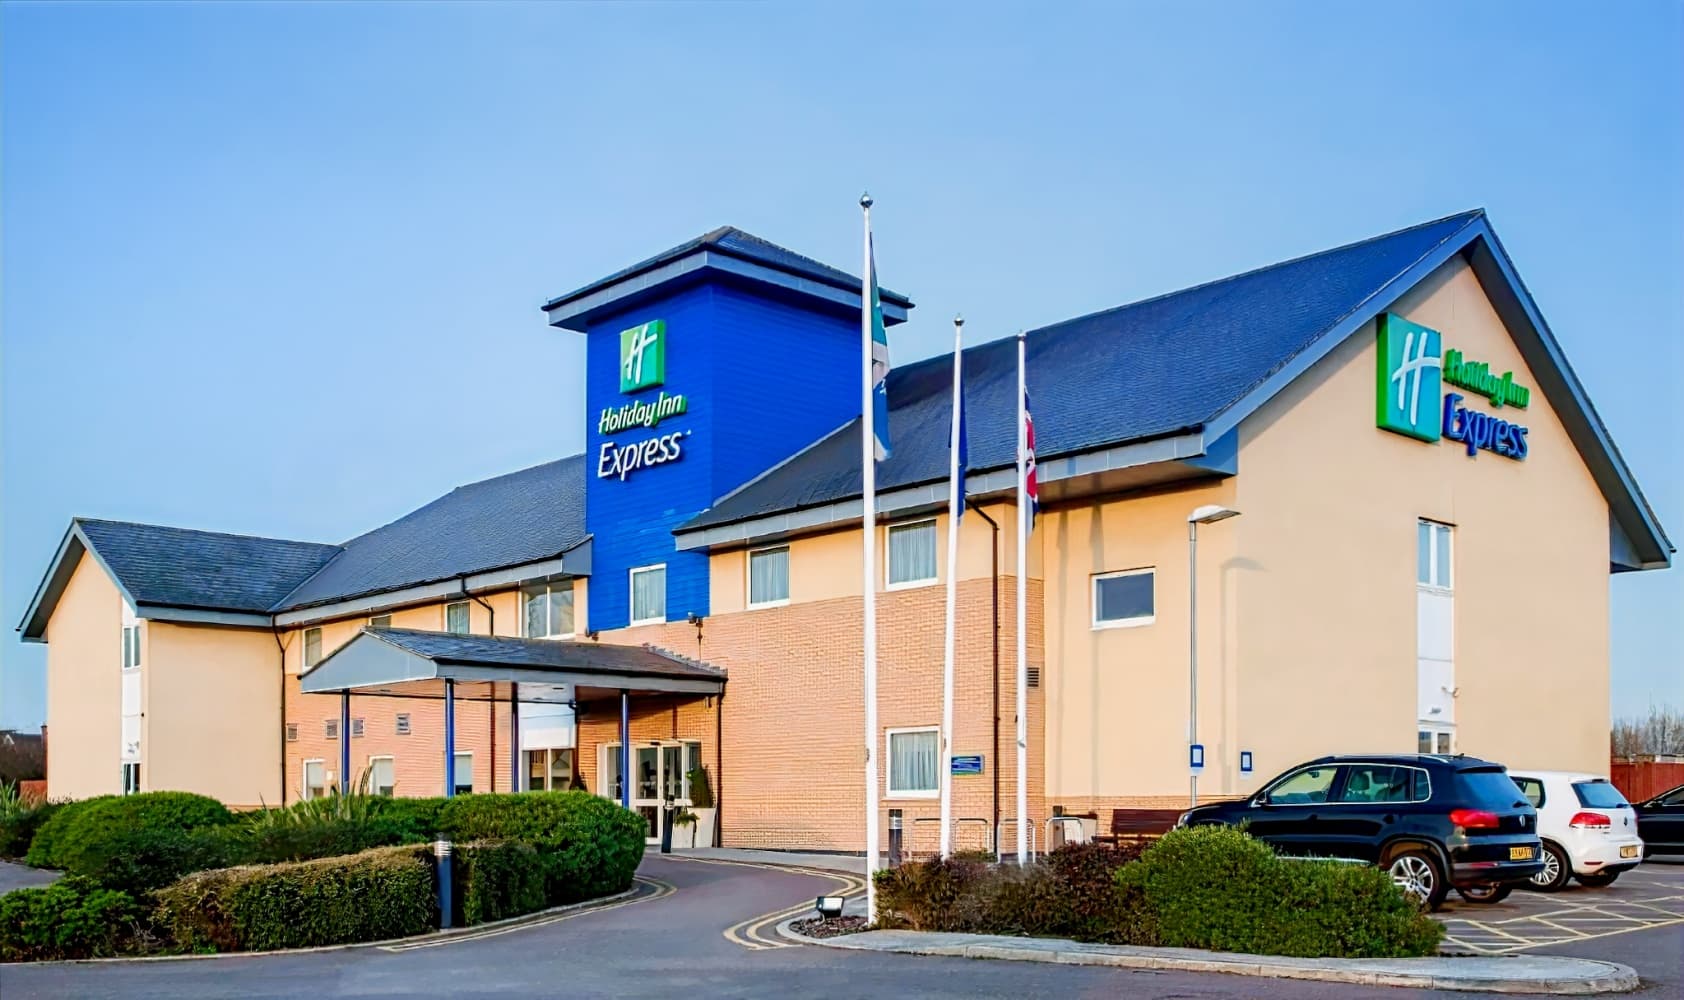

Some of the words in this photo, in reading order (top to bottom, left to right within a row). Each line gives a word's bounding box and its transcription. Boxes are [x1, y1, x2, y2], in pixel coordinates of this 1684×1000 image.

[624, 324, 658, 384] H
[1392, 332, 1441, 426] H
[1443, 348, 1504, 408] Holiday
[1503, 371, 1530, 409] Inn
[599, 400, 657, 434] Holiday
[656, 391, 684, 417] Inn
[1442, 393, 1529, 459] Express
[597, 432, 682, 481] Express
